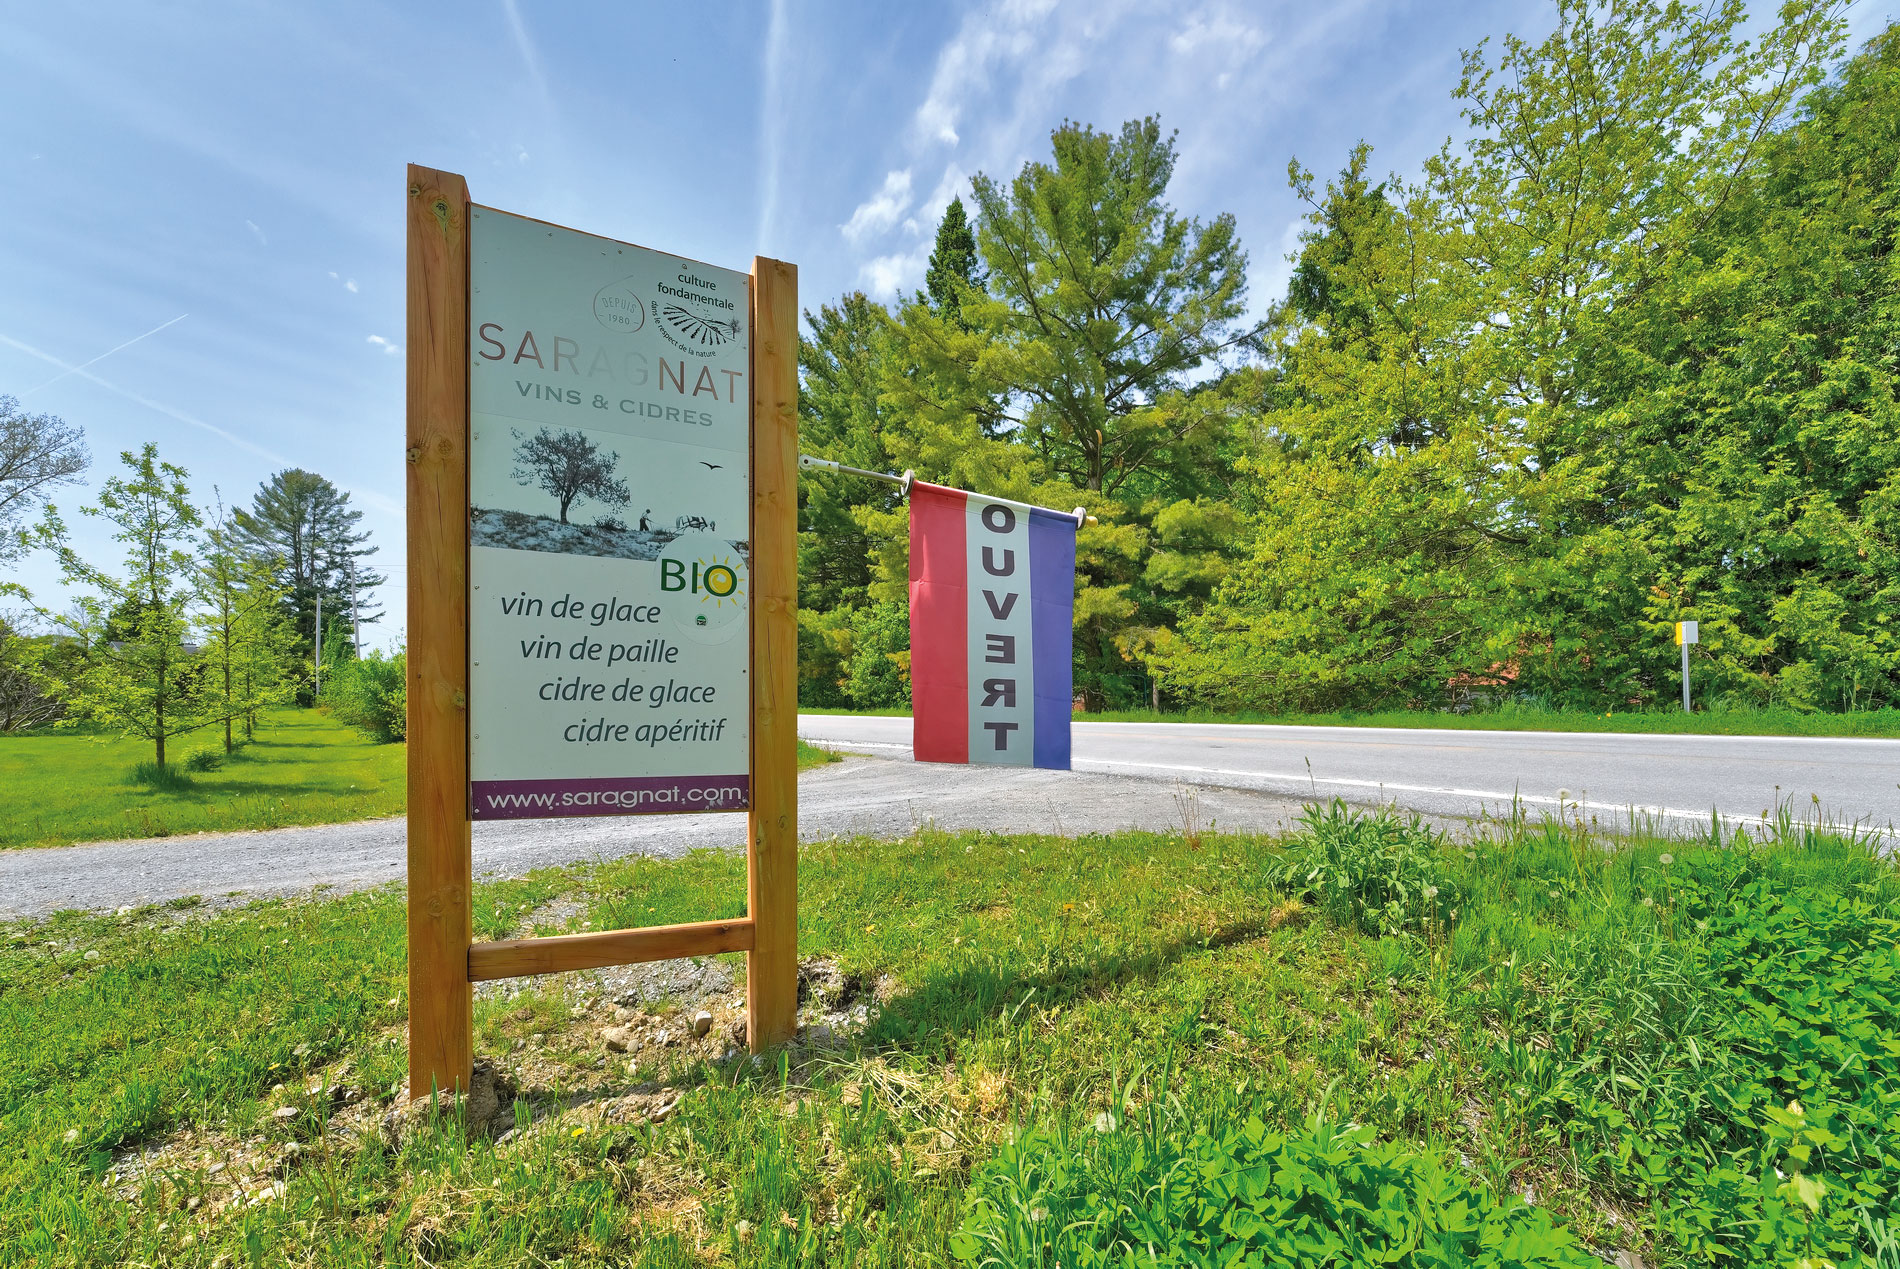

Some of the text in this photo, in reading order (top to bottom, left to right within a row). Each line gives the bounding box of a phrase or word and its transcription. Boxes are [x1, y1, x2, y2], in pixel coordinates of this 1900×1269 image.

[658, 282, 734, 310] fondamentale
[678, 273, 716, 290] culture
[602, 297, 636, 313] DEPUIS
[608, 314, 630, 325] 1980
[658, 324, 678, 347] respect
[679, 343, 687, 352] de
[688, 347, 694, 355] la
[695, 350, 716, 358] nature
[478, 323, 743, 403] SARAGNAT
[515, 381, 713, 427] VINS & CIDRES
[660, 558, 738, 597] BIO
[501, 592, 661, 626] vin de glace
[520, 635, 679, 667] vin de paille
[539, 677, 716, 708] cidre de glace
[563, 718, 727, 747] cidre apéritif
[486, 785, 742, 809] www.saragnat.com
